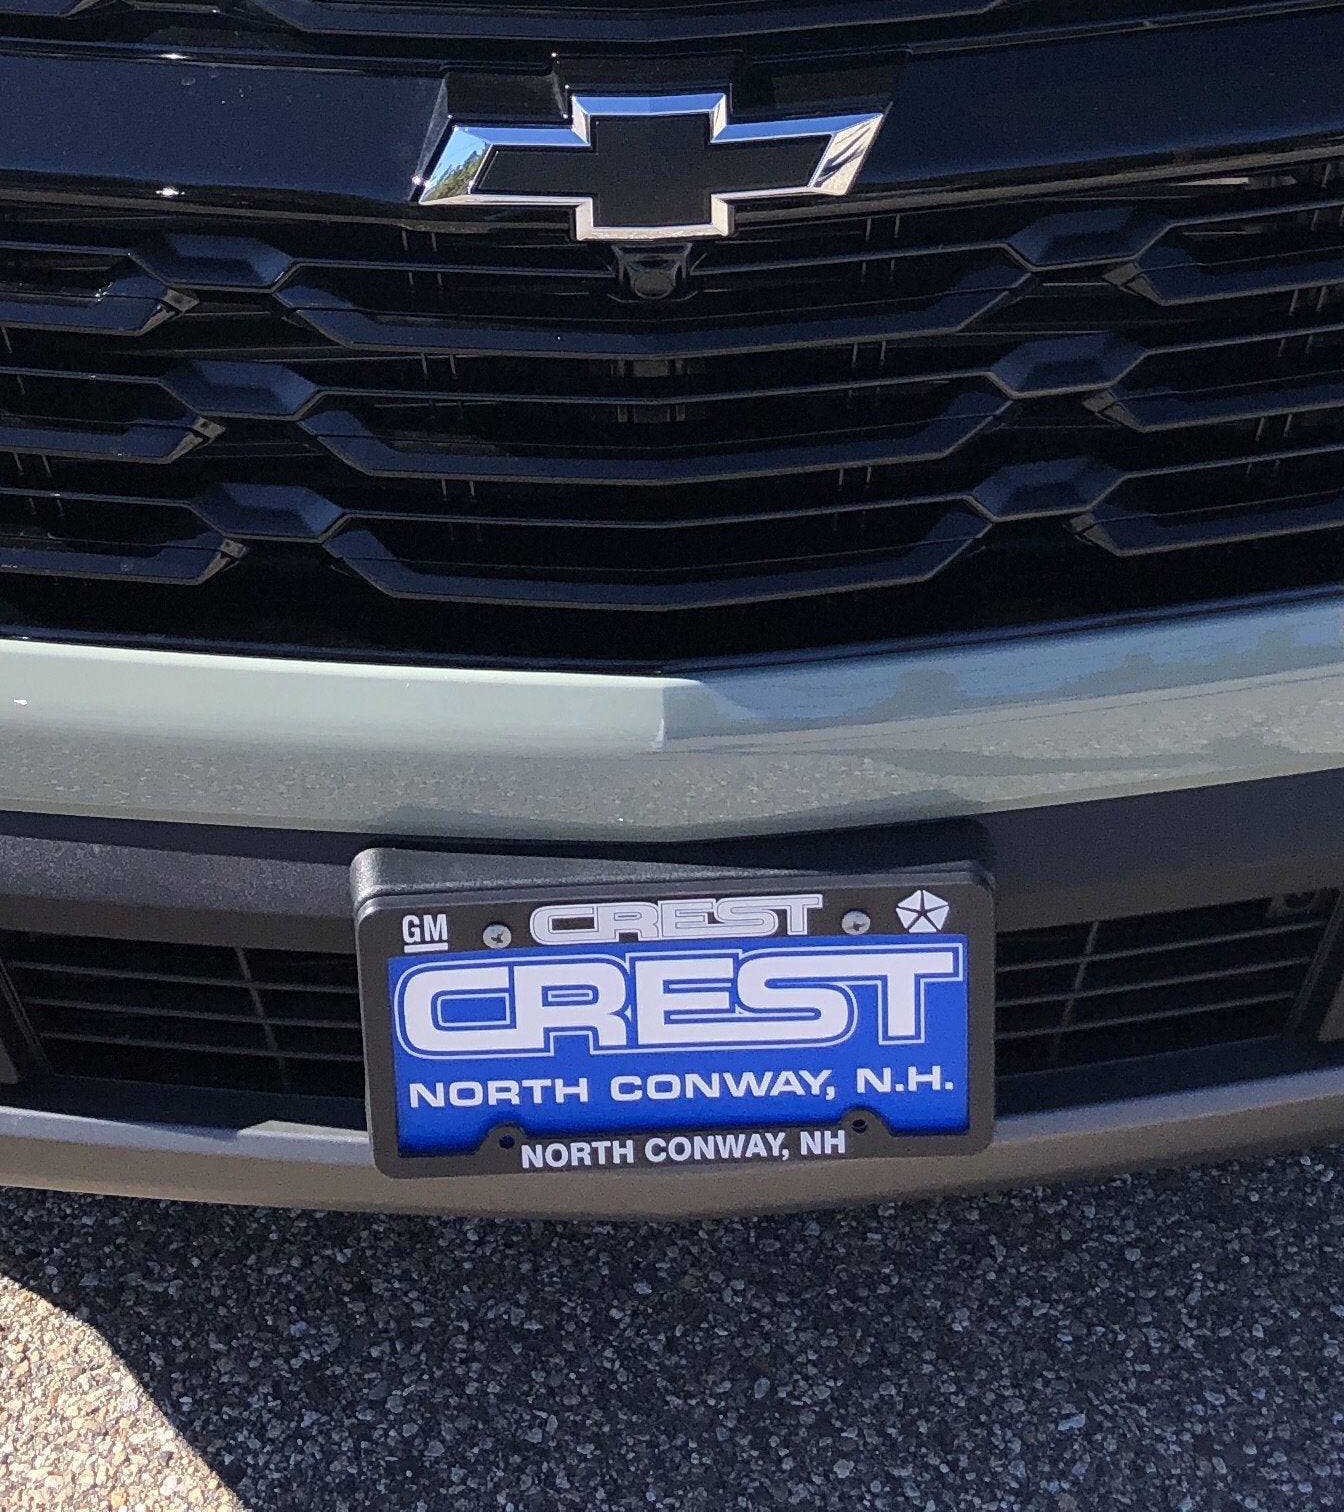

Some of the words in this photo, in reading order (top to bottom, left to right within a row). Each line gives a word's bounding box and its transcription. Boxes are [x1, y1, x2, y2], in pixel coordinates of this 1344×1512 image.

[402, 914, 450, 943] GM
[529, 893, 824, 945] CREST
[396, 942, 965, 1060] CREST
[409, 1077, 589, 1109] NORTH
[610, 1069, 837, 1102] CONWAY,
[856, 1065, 955, 1094] N.H.
[520, 1136, 635, 1170] NORTH
[644, 1131, 791, 1163] CONWAY,
[800, 1130, 847, 1156] NH
